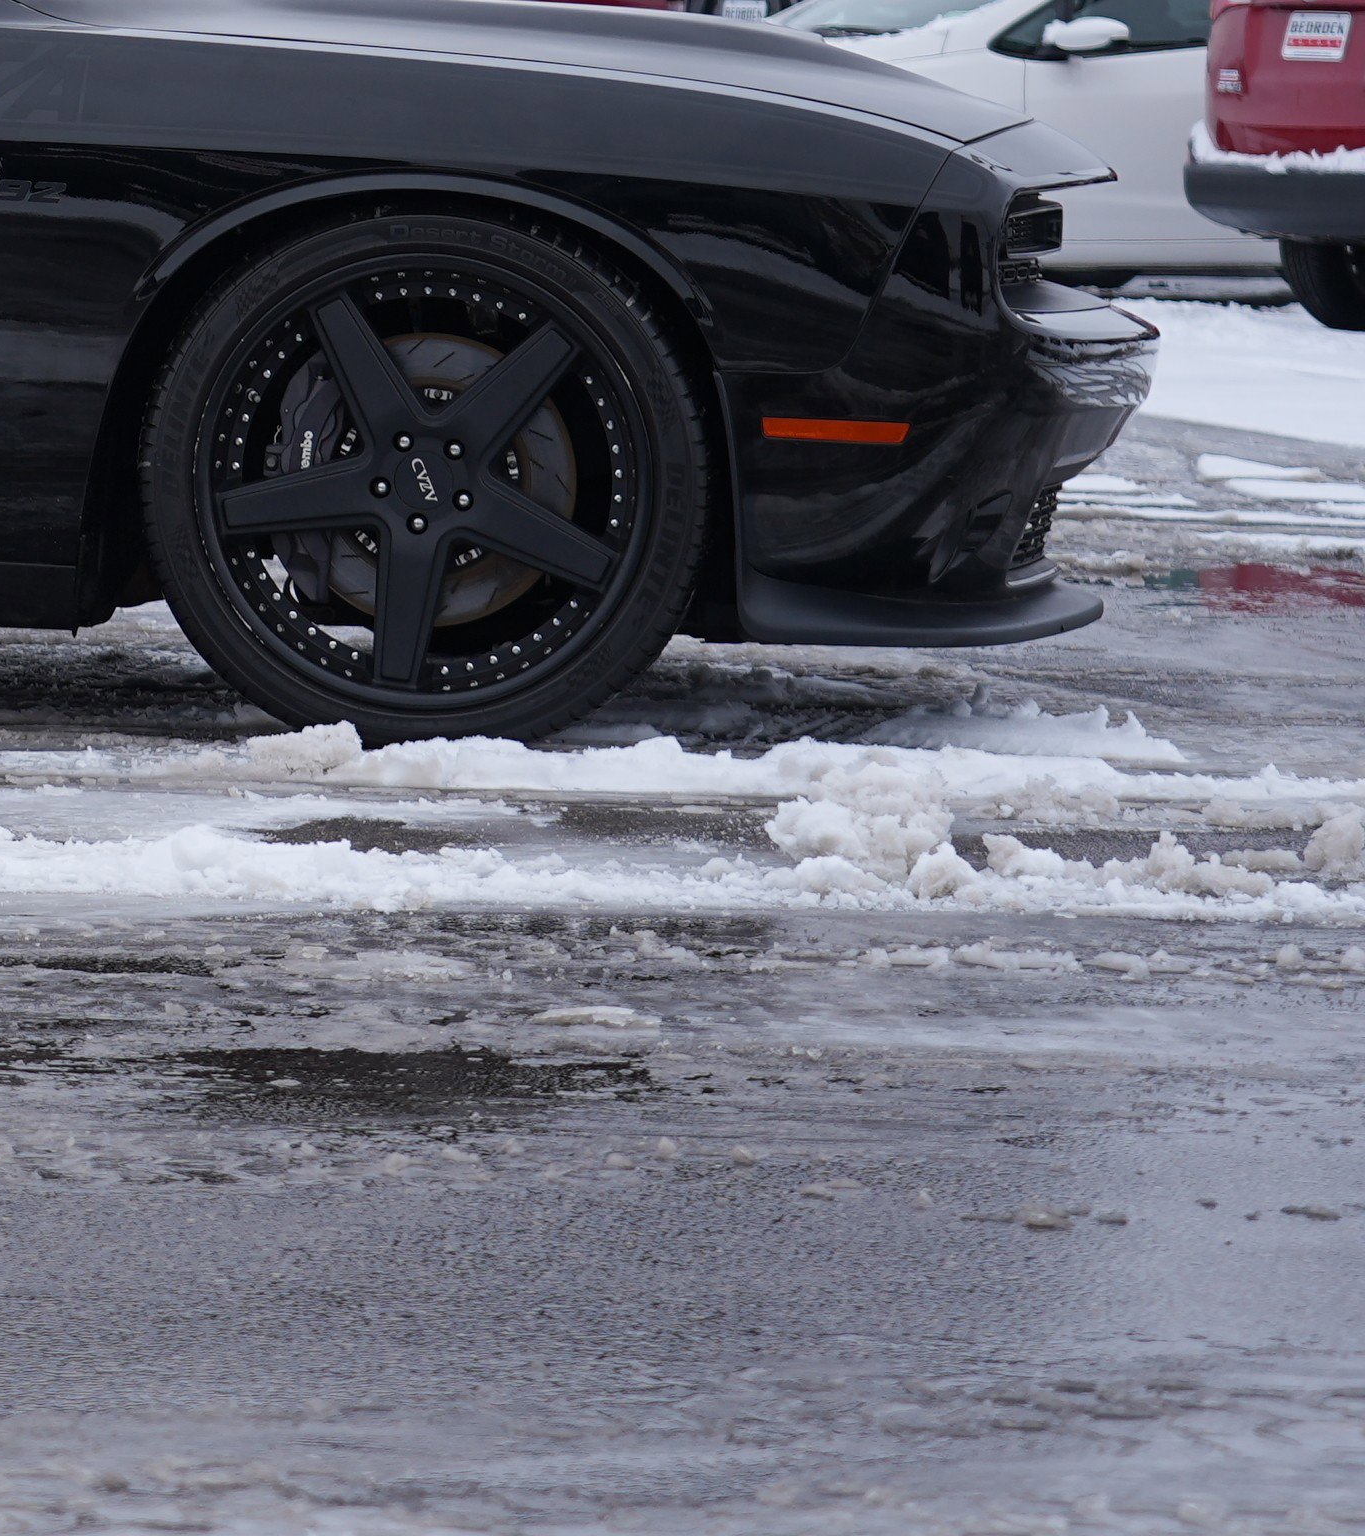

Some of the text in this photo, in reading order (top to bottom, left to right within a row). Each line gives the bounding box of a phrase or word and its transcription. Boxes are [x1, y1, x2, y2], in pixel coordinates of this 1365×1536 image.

[1290, 20, 1345, 34] BEDROCK
[389, 223, 483, 241] Desert
[489, 233, 569, 282] Storm
[300, 430, 314, 470] embo
